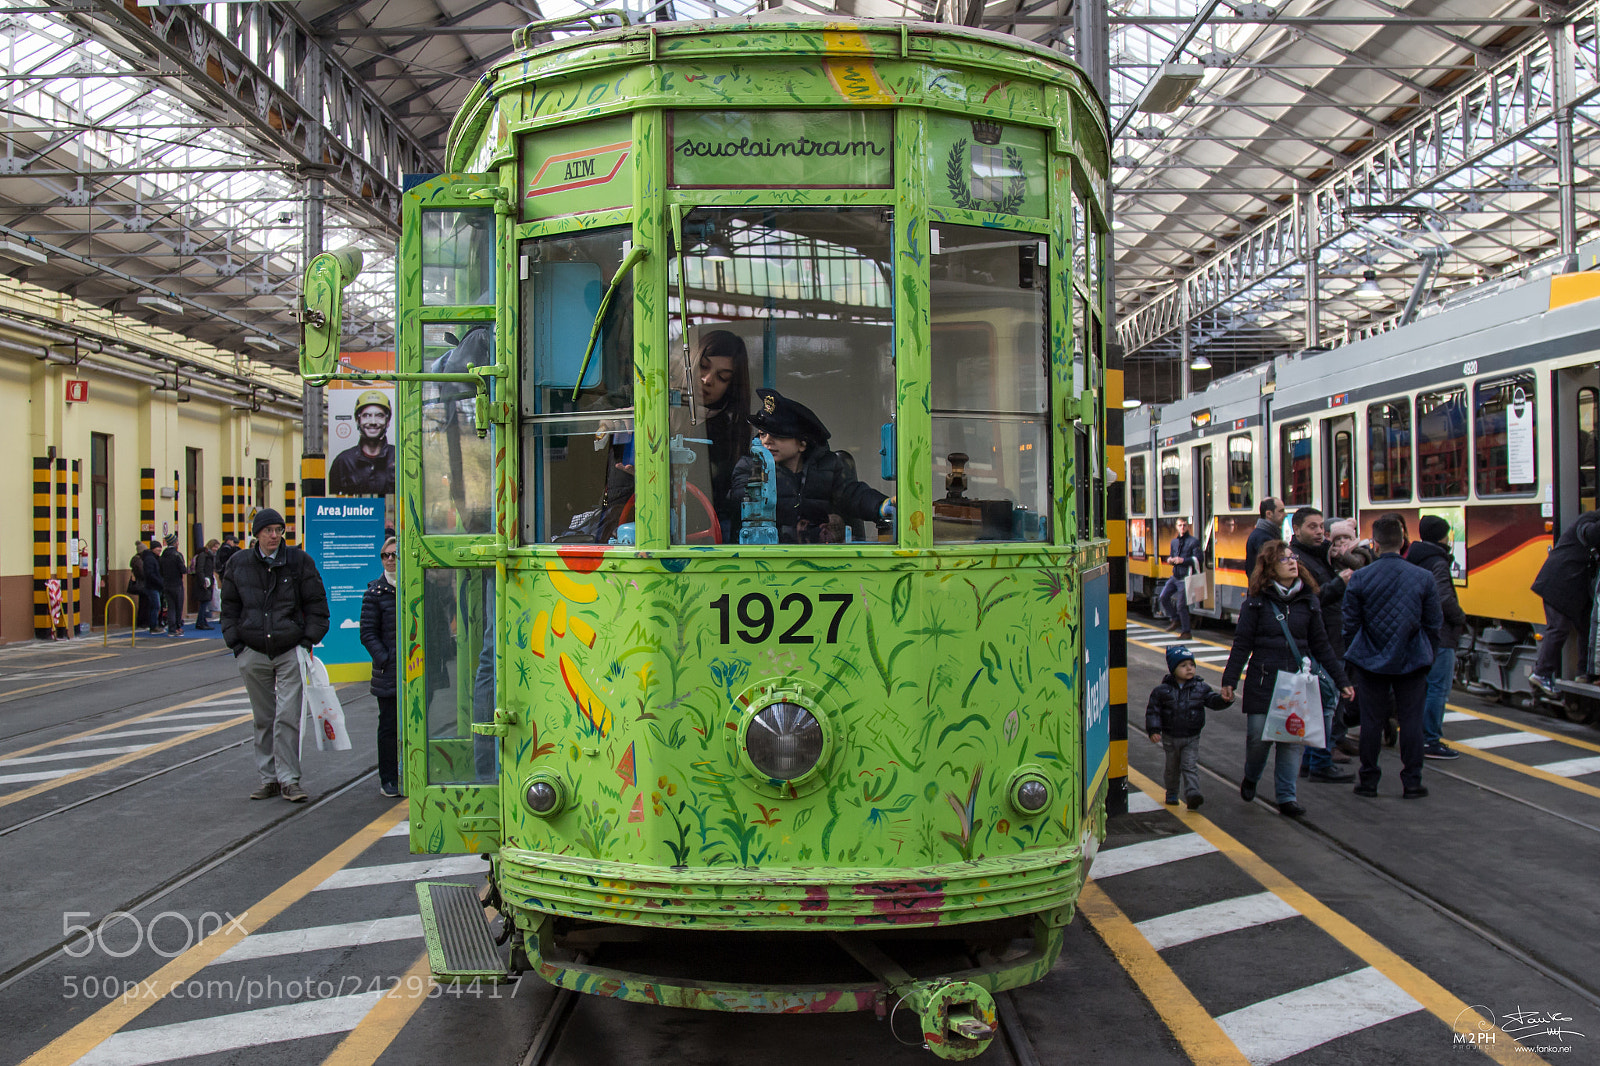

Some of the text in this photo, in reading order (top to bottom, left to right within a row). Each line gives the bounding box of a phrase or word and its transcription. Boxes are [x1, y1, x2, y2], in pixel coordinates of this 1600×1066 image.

[675, 136, 885, 158] scuolaintram
[563, 158, 596, 180] ATM
[1463, 360, 1478, 375] 4920
[316, 504, 374, 518] Area Junior
[709, 592, 853, 644] 1927
